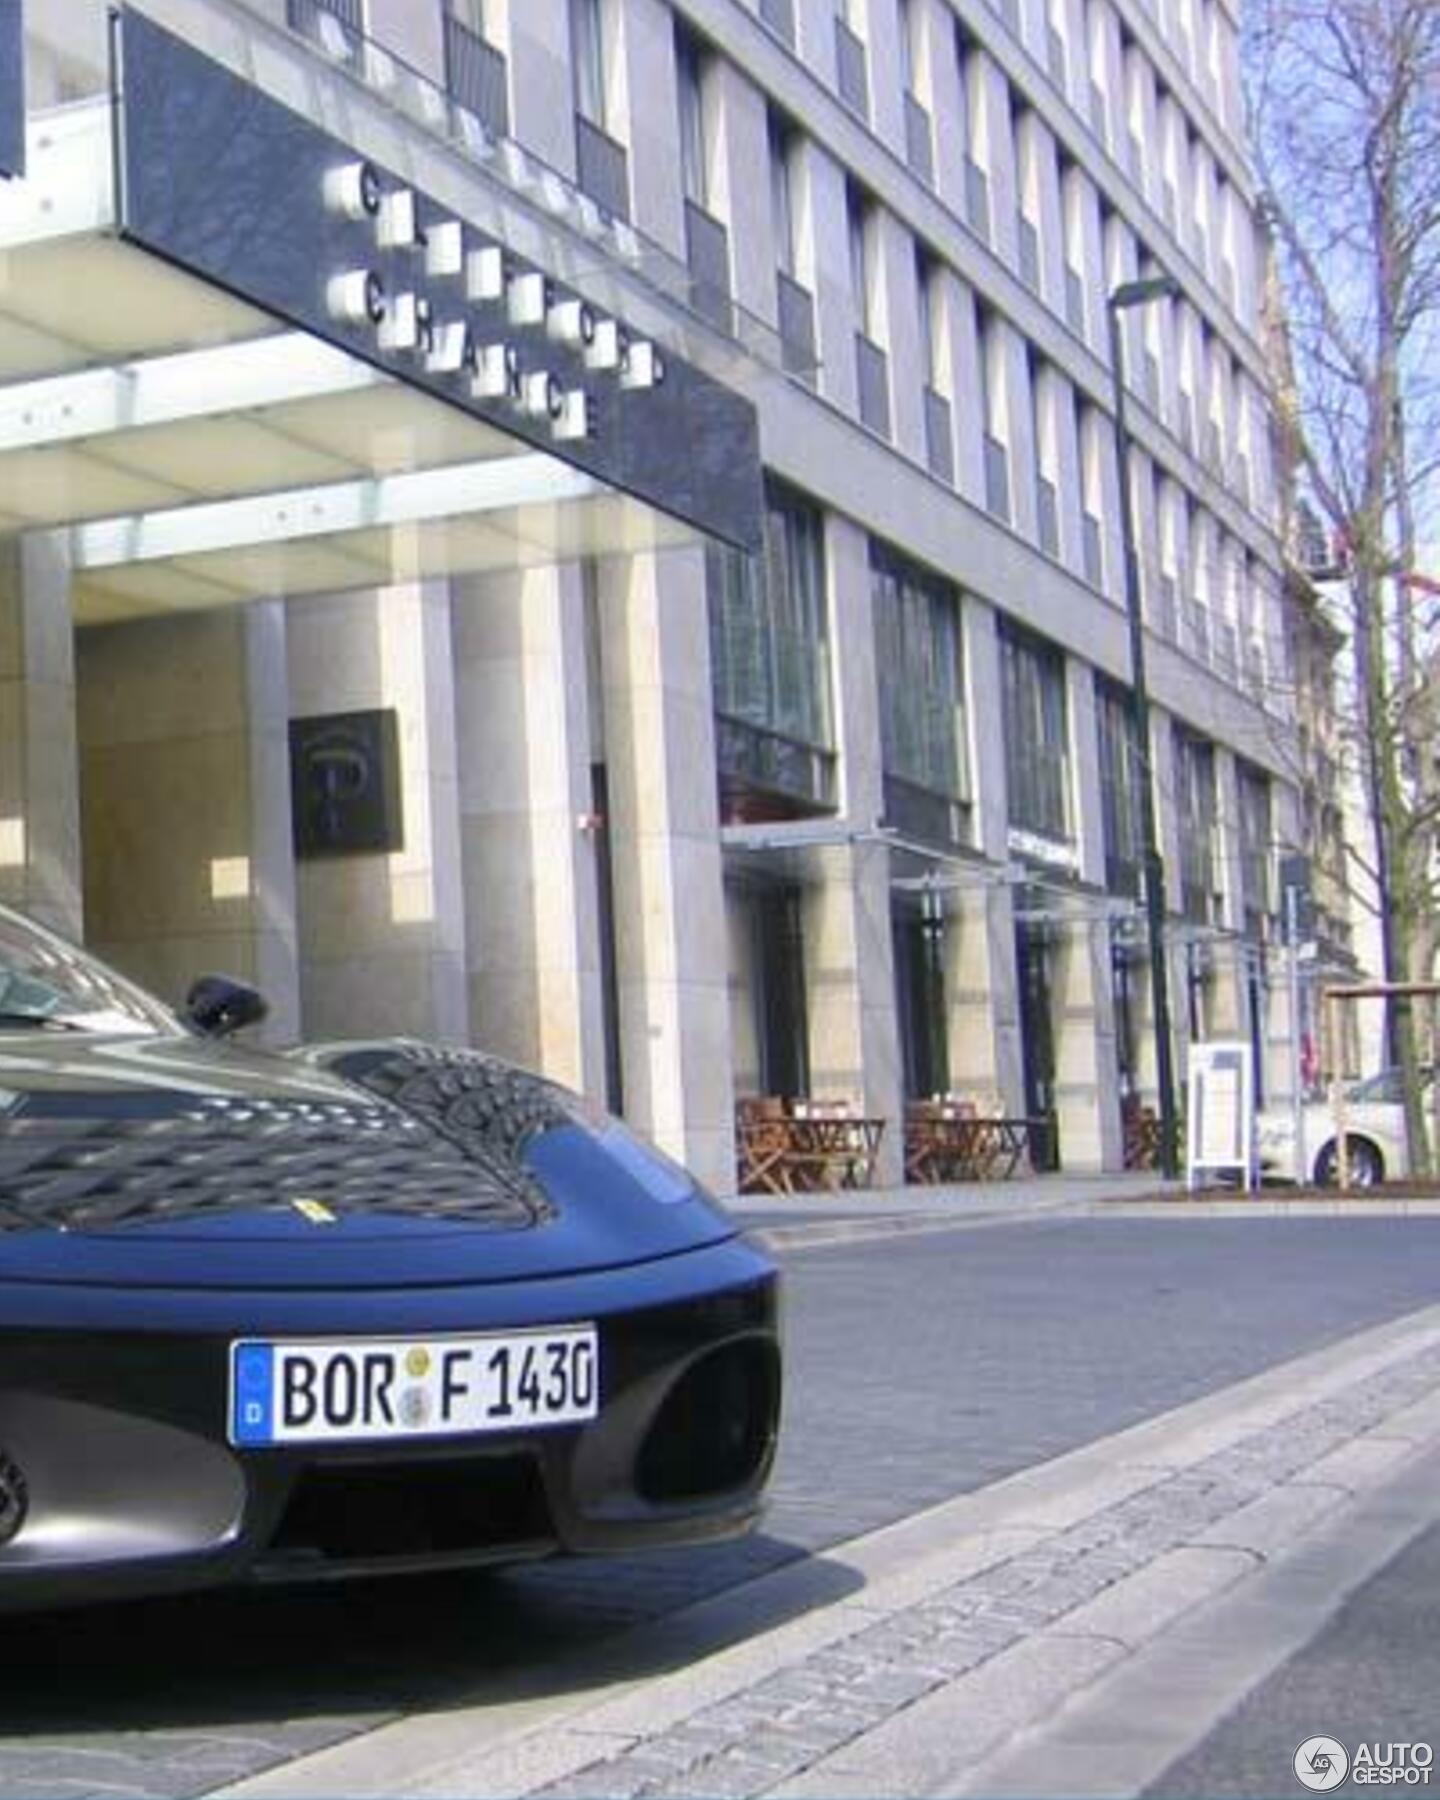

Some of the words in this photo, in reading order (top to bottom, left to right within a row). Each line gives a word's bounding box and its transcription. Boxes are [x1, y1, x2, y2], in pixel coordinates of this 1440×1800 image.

[283, 1353, 396, 1427] BOR
[441, 1349, 472, 1420] F
[486, 1341, 592, 1417] 1430
[245, 1403, 261, 1423] D
